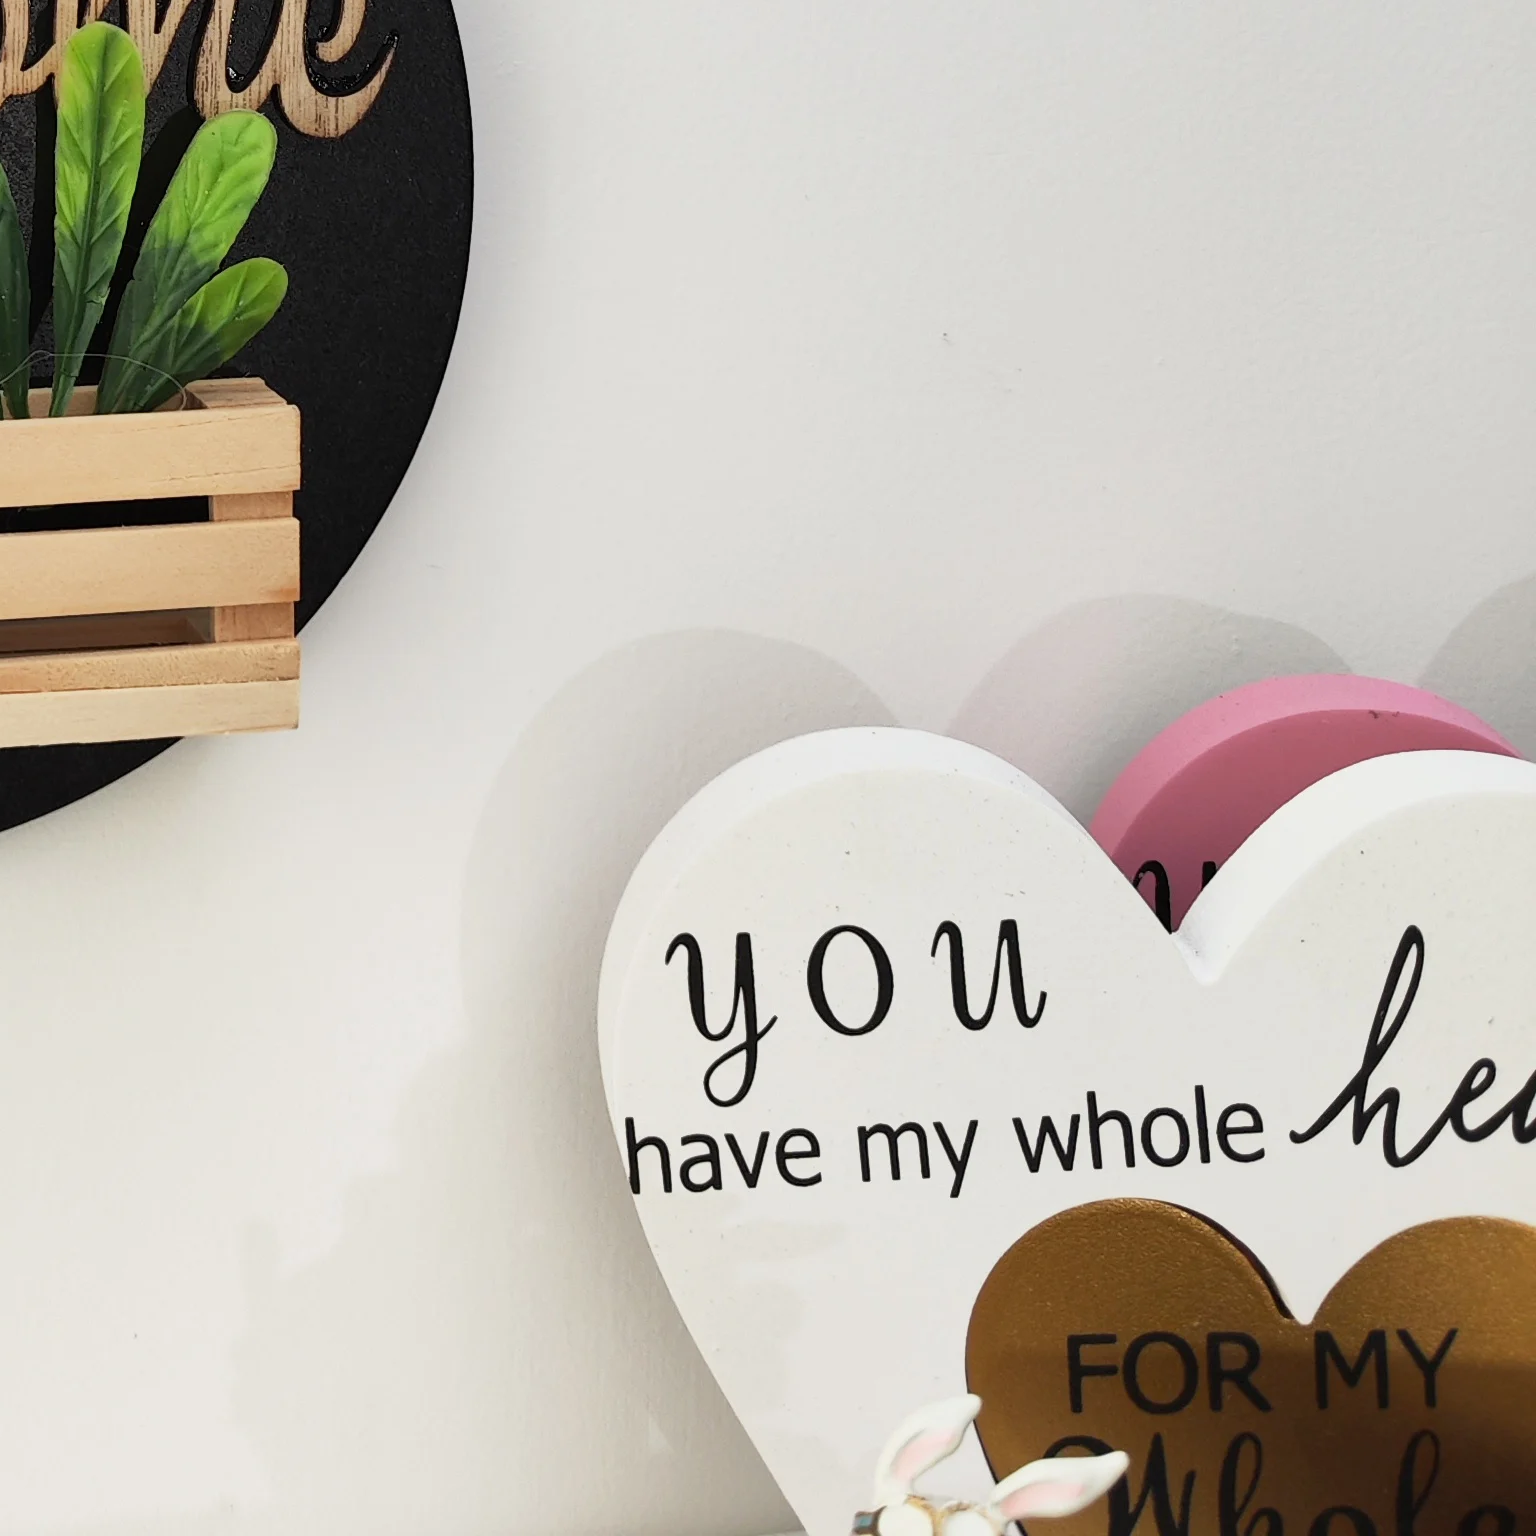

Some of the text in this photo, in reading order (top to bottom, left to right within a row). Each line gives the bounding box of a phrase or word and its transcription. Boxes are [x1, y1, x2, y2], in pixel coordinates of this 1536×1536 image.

[665, 918, 1048, 1108] you
[625, 1116, 822, 1194] have
[857, 1119, 979, 1199] my
[1012, 1084, 1265, 1174] whole
[1067, 1327, 1459, 1415] FOR MY
